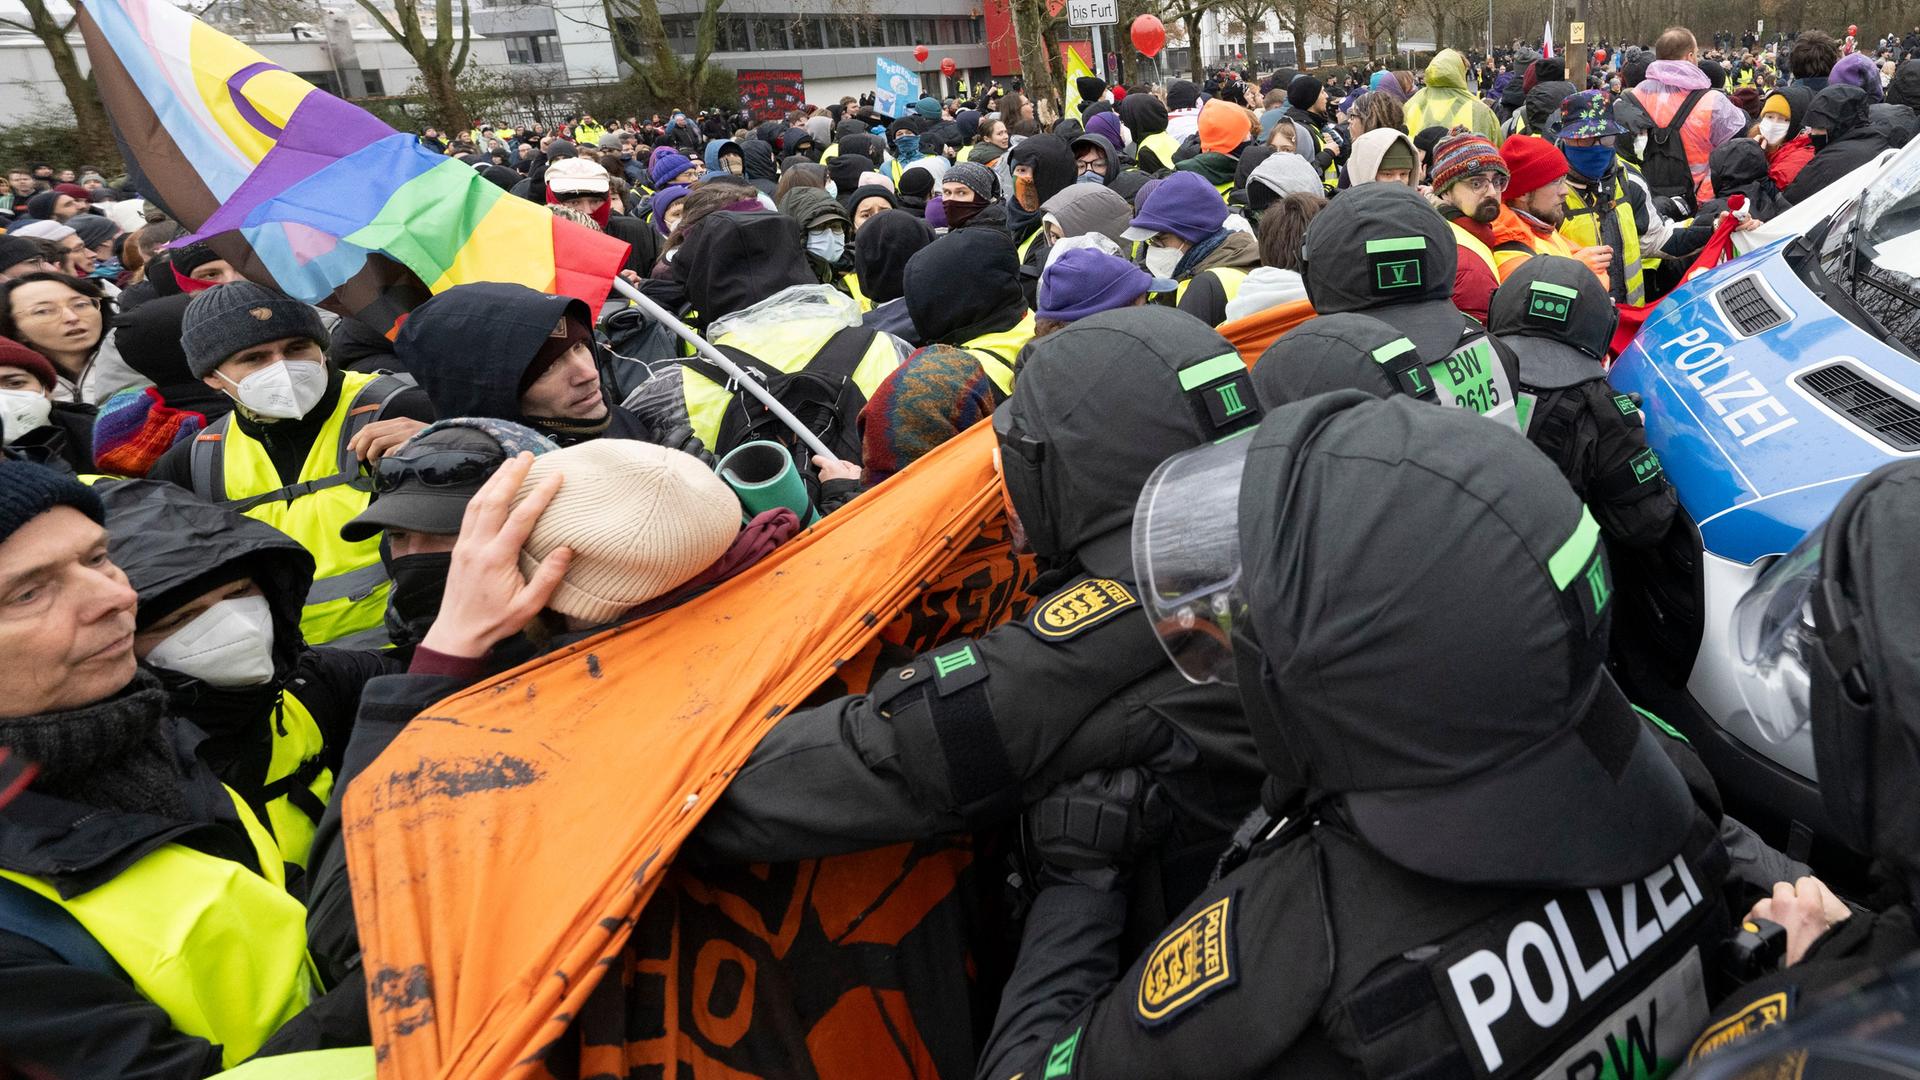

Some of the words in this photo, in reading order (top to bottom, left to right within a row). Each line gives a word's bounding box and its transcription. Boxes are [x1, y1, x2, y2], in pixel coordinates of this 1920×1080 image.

[1072, 4, 1088, 19] bis
[1090, 3, 1113, 18] Furt
[1444, 346, 1482, 386] BW
[1660, 326, 1799, 447] POLIZEI
[1204, 908, 1221, 977] POLIZEI
[1447, 853, 1704, 1073] POLIZEI
